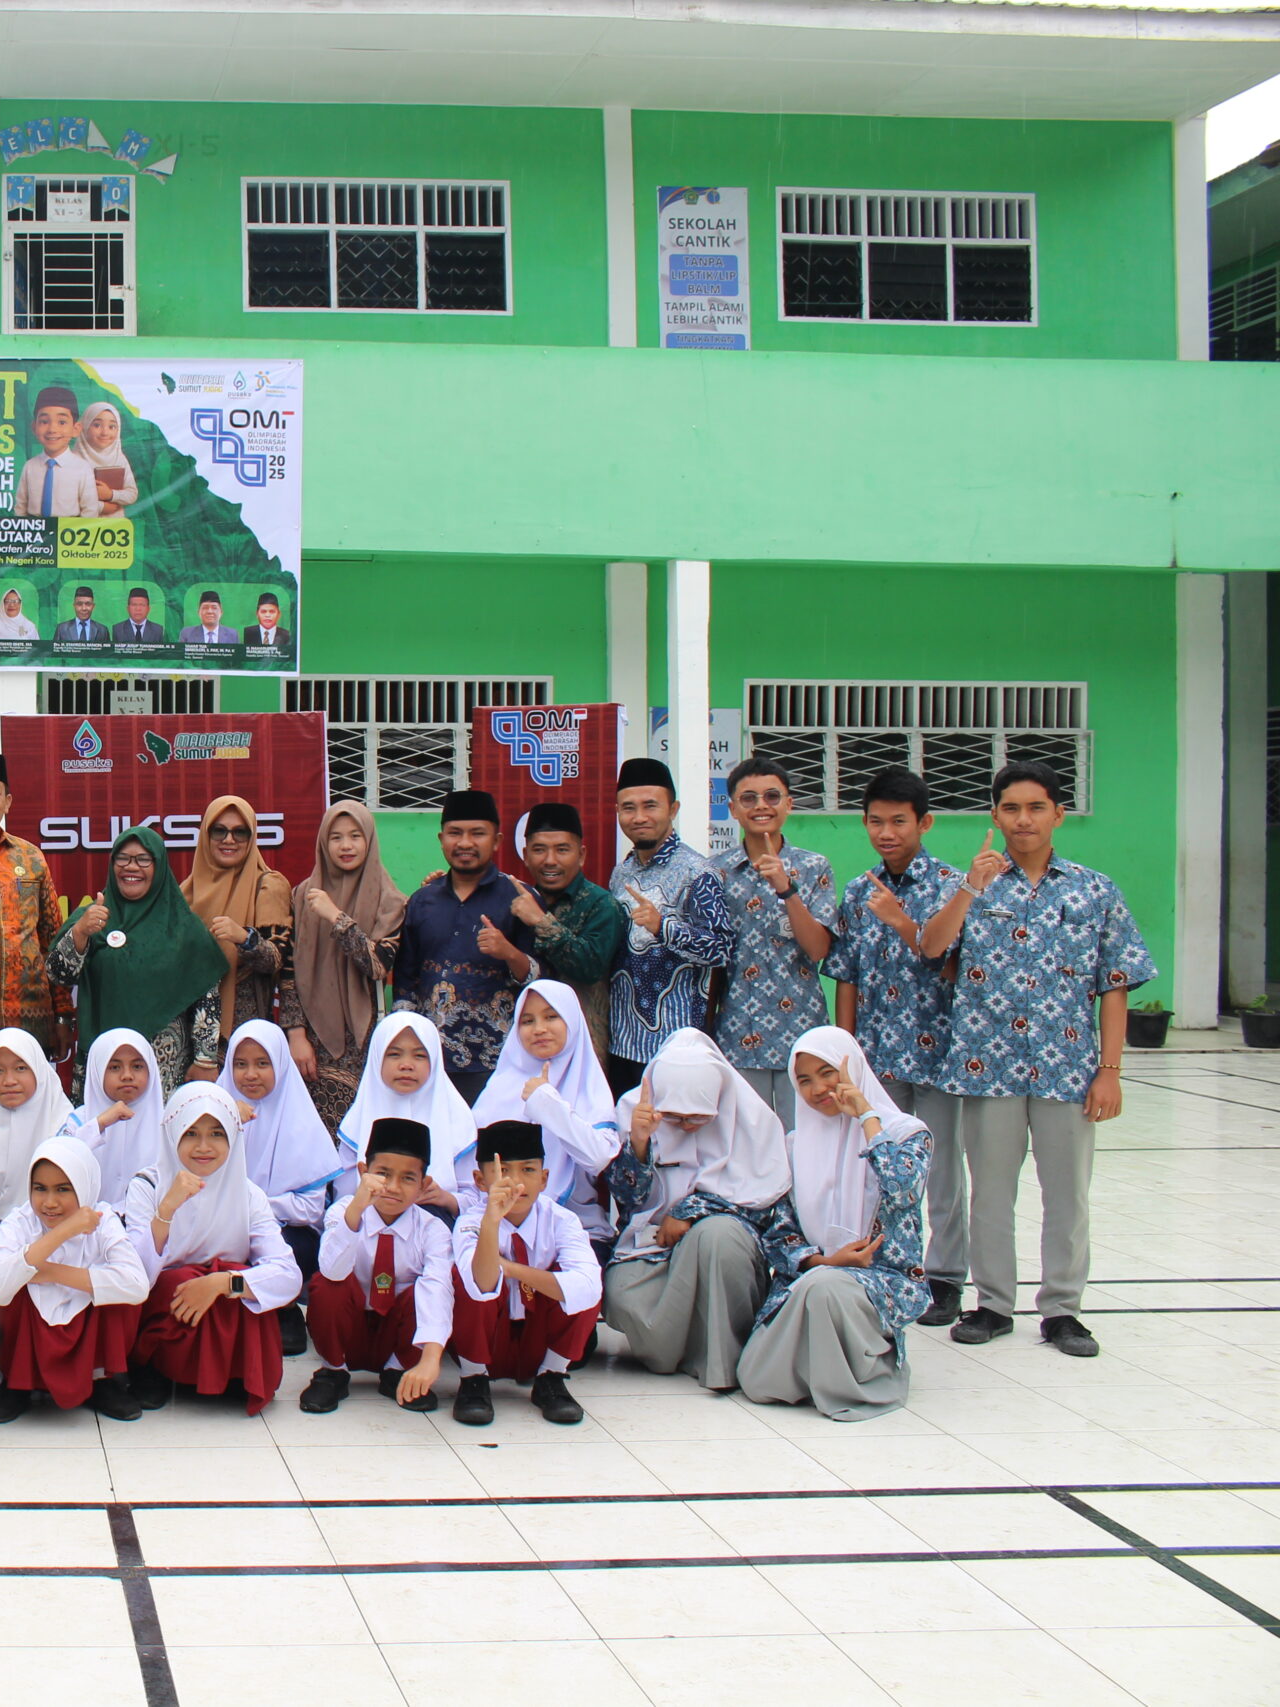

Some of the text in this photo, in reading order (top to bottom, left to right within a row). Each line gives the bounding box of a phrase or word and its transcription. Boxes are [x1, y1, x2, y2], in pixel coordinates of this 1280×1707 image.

[668, 217, 736, 230] SEKOLAH
[675, 235, 731, 248] CANTIK
[683, 255, 724, 267] TANPA
[671, 270, 737, 281] LIPSTIK/LIP
[687, 284, 721, 294] BALM
[665, 301, 744, 312] TAMPIL ALAMI
[667, 315, 743, 325] LEBIH CANTIK
[268, 455, 286, 467] 20
[268, 468, 286, 480] 25
[59, 527, 130, 551] 02/03
[25, 543, 54, 556] Karo)
[61, 550, 129, 560] Oktober 2025
[5, 556, 34, 567] Negeri
[35, 557, 55, 566] Karo
[174, 732, 252, 747] MADRASAH
[174, 748, 213, 759] SUMUT
[563, 753, 578, 764] 20
[62, 757, 113, 769] pusaka
[563, 766, 578, 777] 25
[40, 813, 284, 850] SUKSS
